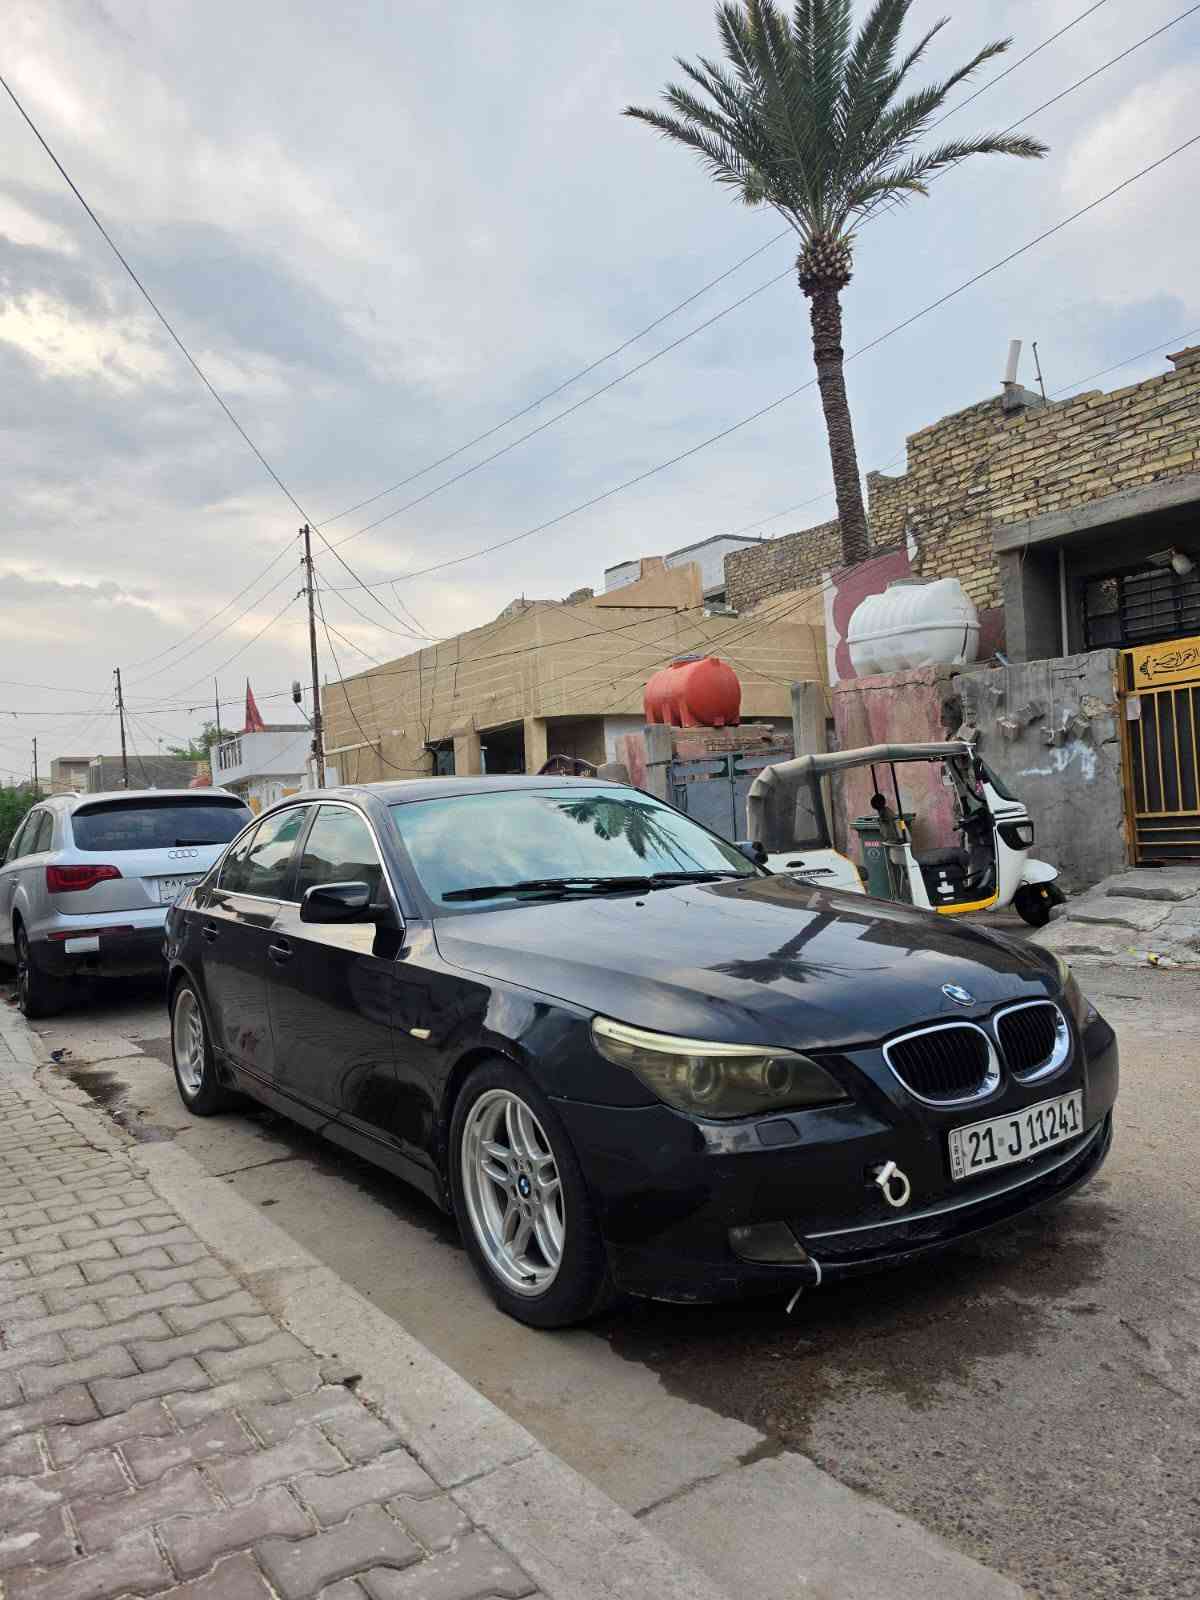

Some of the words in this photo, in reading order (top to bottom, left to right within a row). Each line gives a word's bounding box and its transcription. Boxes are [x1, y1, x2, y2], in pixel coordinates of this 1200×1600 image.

[968, 1127, 998, 1167] 21
[1008, 1120, 1022, 1156] J
[1026, 1099, 1079, 1150] 11241
